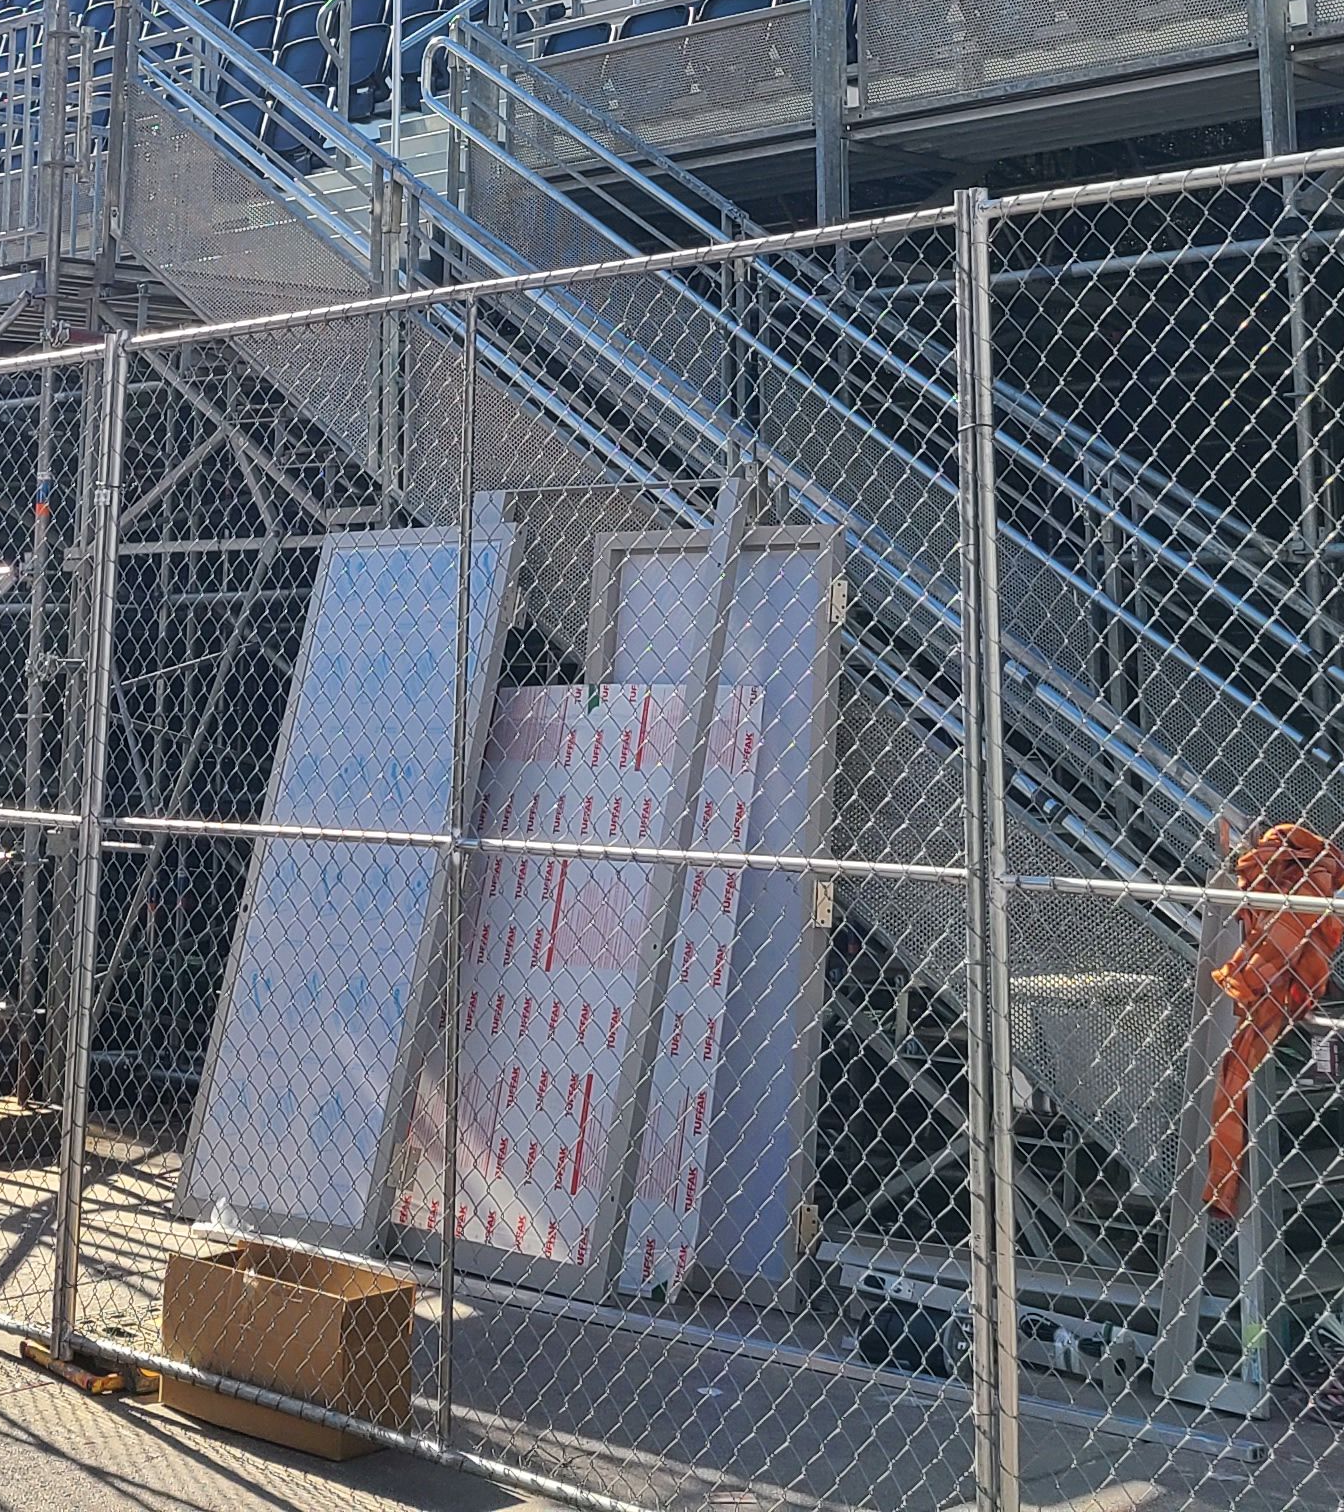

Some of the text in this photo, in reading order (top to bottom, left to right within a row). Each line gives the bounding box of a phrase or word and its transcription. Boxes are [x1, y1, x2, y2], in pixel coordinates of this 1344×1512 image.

[619, 729, 632, 769] TUFFAK
[580, 795, 593, 836] TUFFAK
[609, 796, 622, 838] TUFFAK
[639, 797, 652, 839] TUFFAK
[489, 856, 503, 898] TUFFAK
[515, 858, 528, 899] TUFFAK
[542, 859, 555, 902] TUFFAK
[722, 870, 736, 914] TUFFAK
[477, 923, 490, 964] TUFFAK
[503, 924, 516, 967] TUFFAK
[530, 928, 543, 969] TUFFAK
[464, 990, 478, 1032] TUFFAK
[491, 992, 505, 1036] TUFFAK
[547, 999, 560, 1040] FFAK
[693, 1091, 707, 1136] TUFFAK
